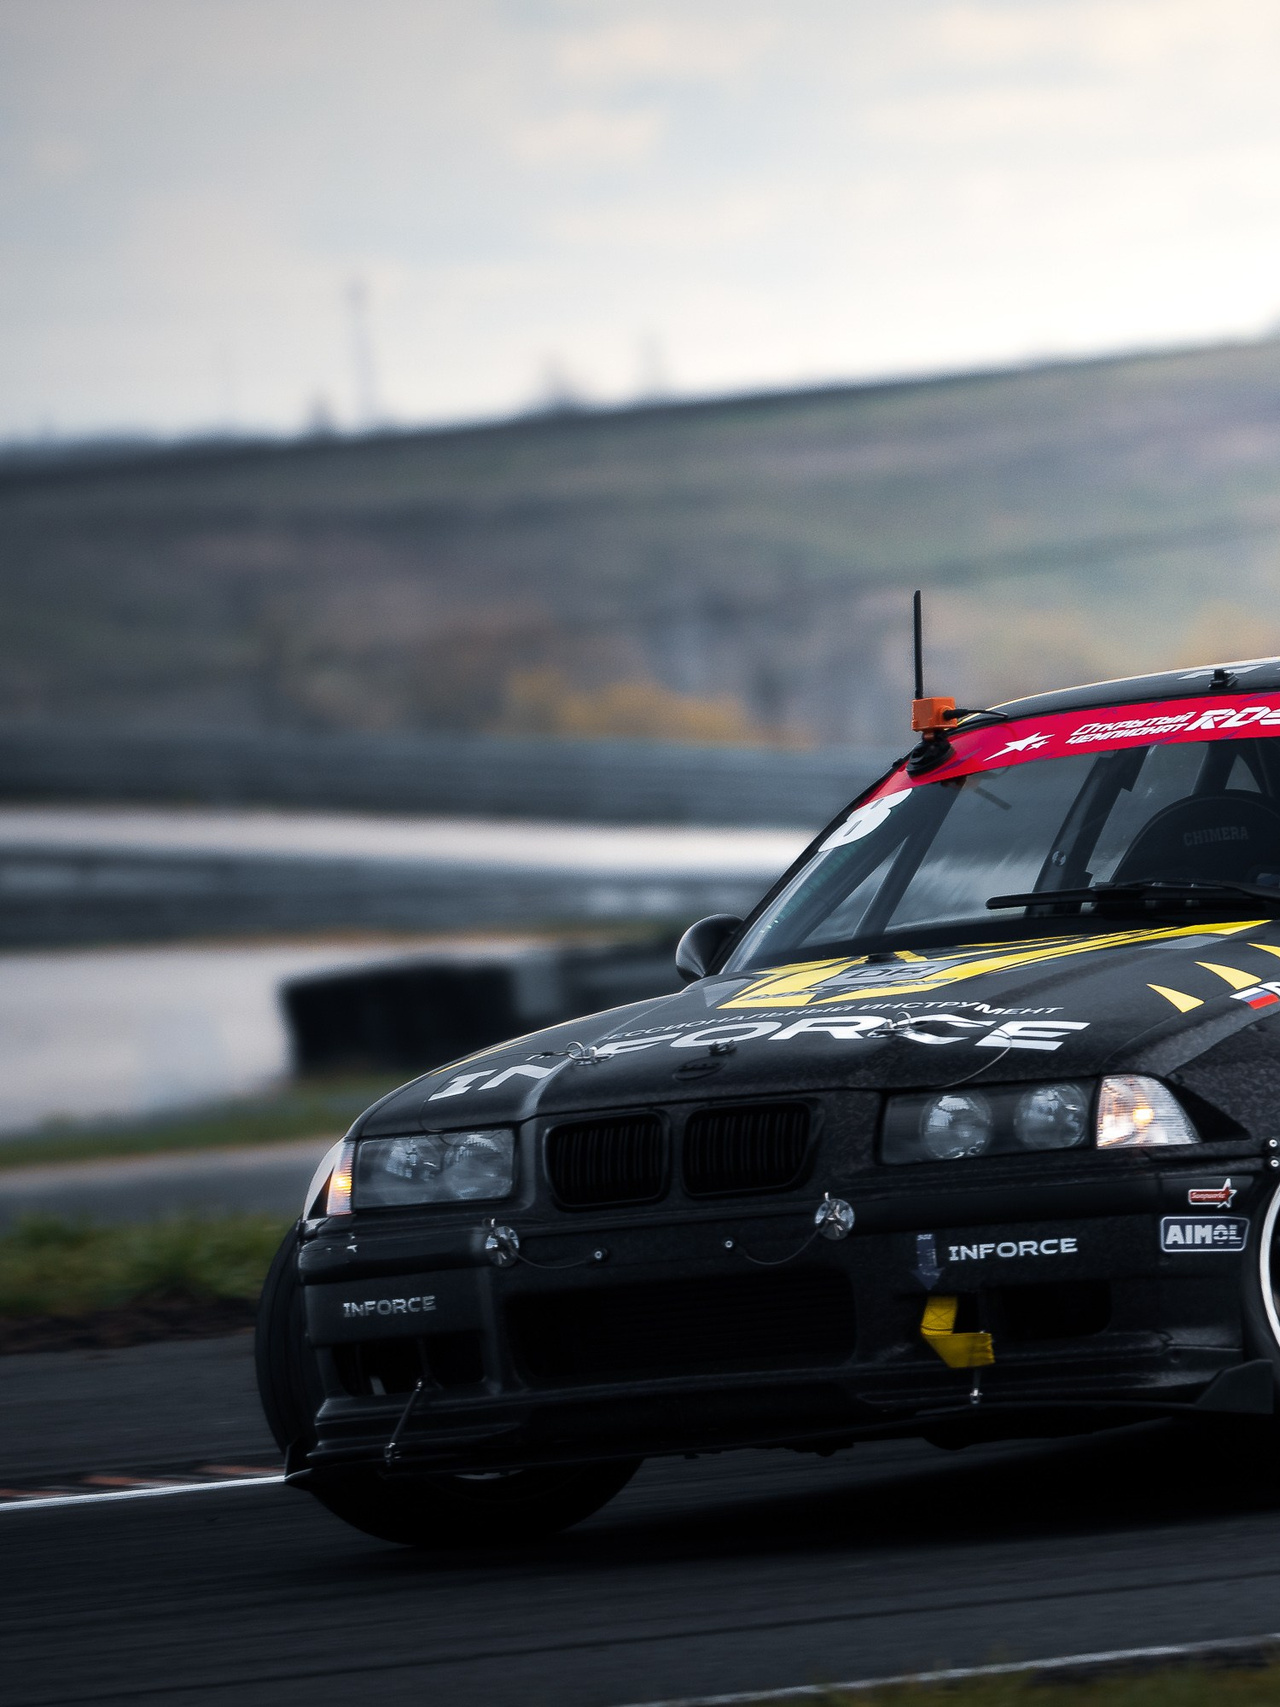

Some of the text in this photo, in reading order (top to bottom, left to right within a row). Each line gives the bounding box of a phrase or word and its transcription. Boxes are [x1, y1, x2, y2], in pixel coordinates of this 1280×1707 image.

[1184, 826, 1249, 847] CHIMERA
[858, 1000, 1064, 1016] ИНСТРУМЕНТ
[1165, 1224, 1242, 1245] AIMOL
[948, 1238, 1078, 1262] INFORCE
[343, 1295, 436, 1318] INFORCE
